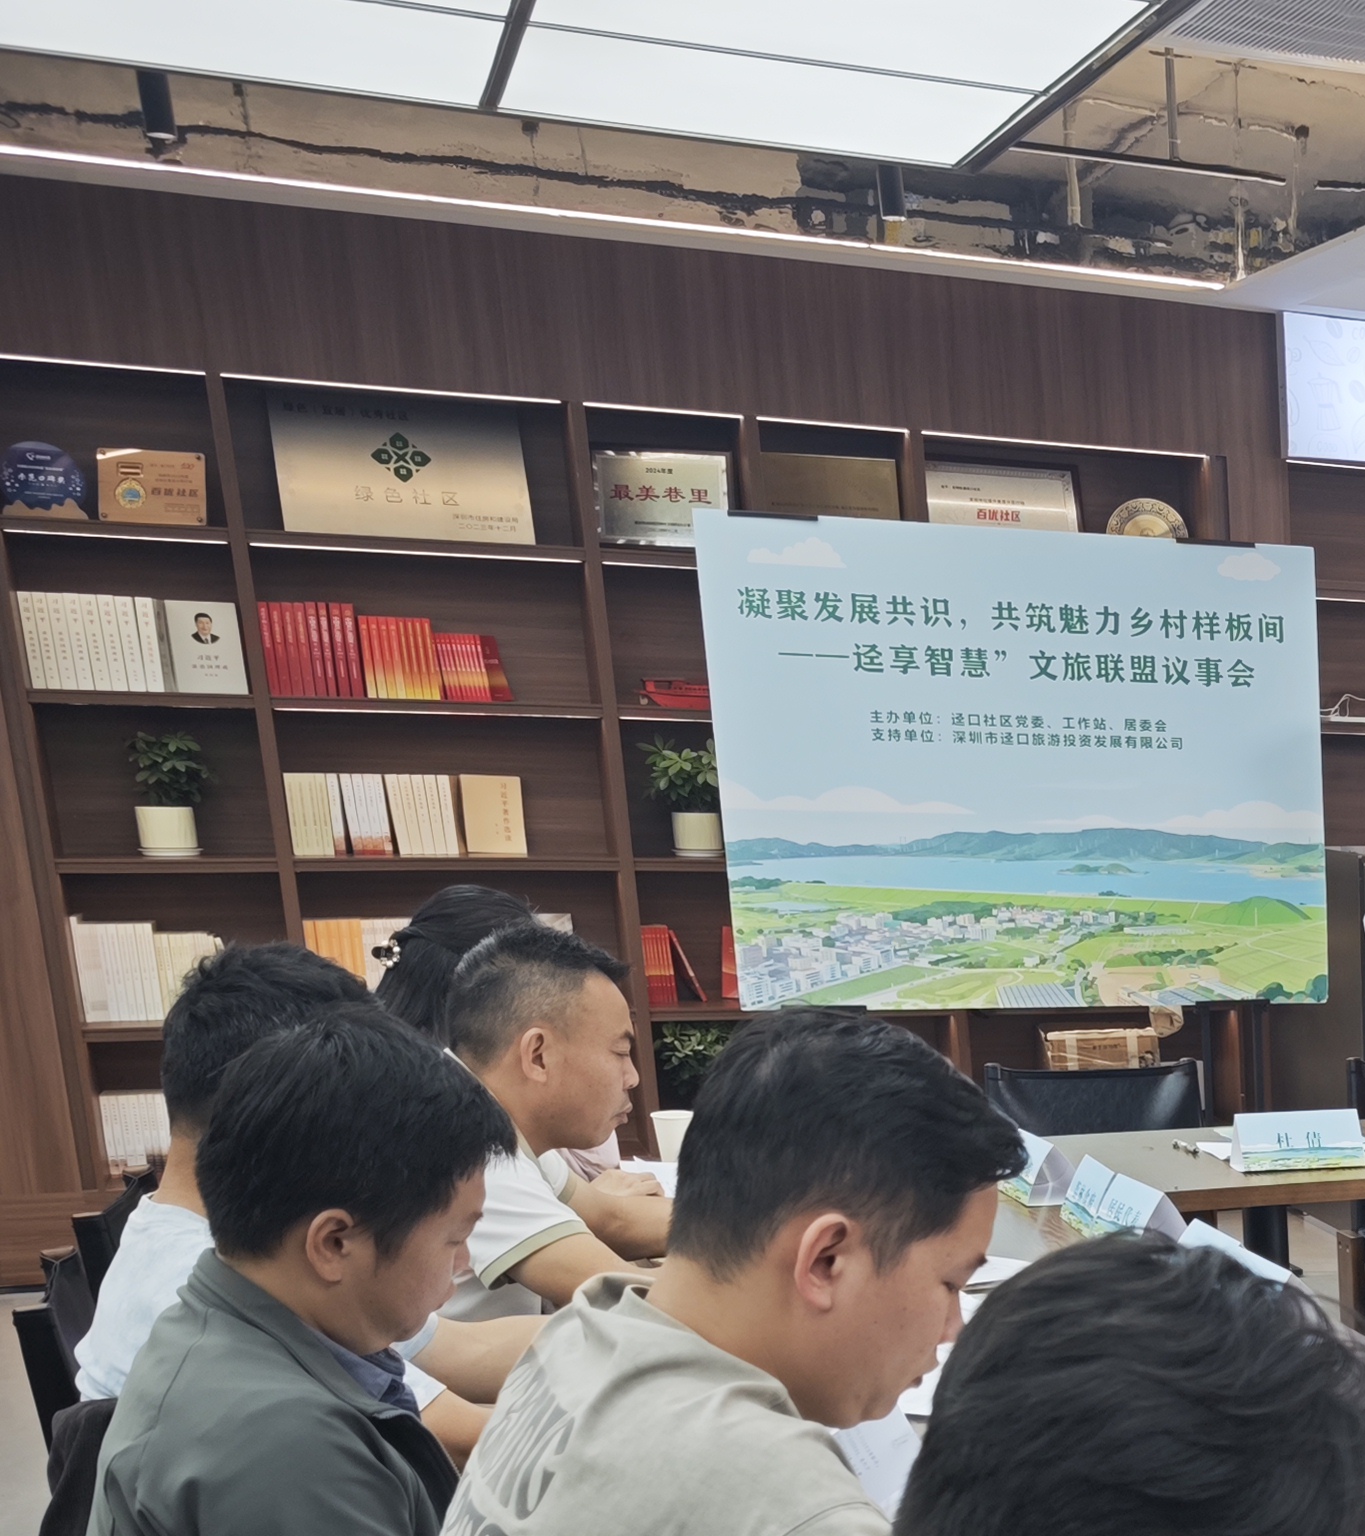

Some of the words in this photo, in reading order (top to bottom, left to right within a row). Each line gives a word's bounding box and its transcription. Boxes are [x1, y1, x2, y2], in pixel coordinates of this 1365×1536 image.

[354, 485, 460, 507] 绿色社区
[610, 484, 712, 505] 最美巷里
[976, 508, 1021, 523] 百优社区
[736, 586, 1287, 645] 凝聚发展共识，共筑魅力乡村样板间
